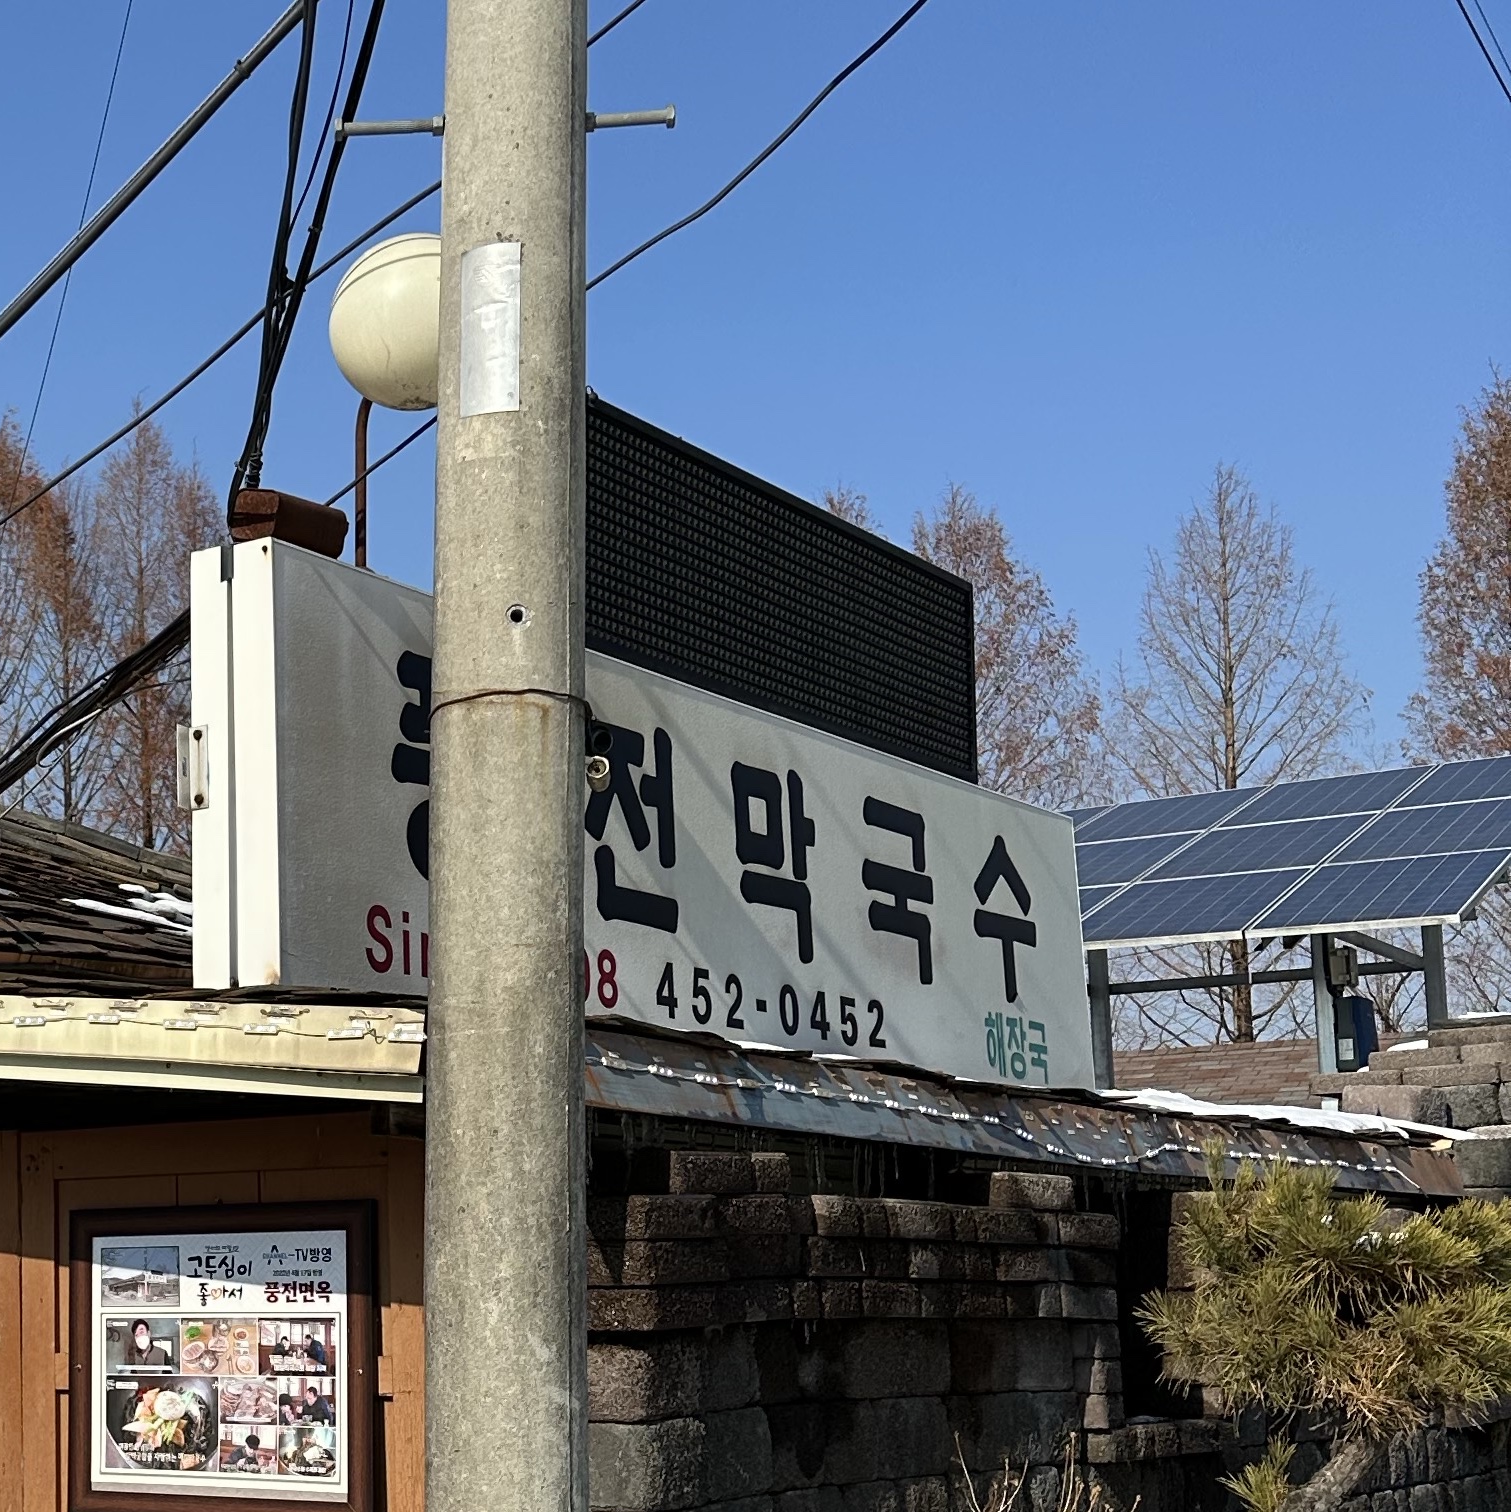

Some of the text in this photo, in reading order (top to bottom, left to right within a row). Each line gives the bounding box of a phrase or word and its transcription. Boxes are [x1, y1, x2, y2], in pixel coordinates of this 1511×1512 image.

[656, 961, 887, 1049] 452-0452
[984, 1011, 1050, 1086] 해장국
[186, 1254, 253, 1280] 고두심이
[264, 1280, 333, 1304] 풍전면옥
